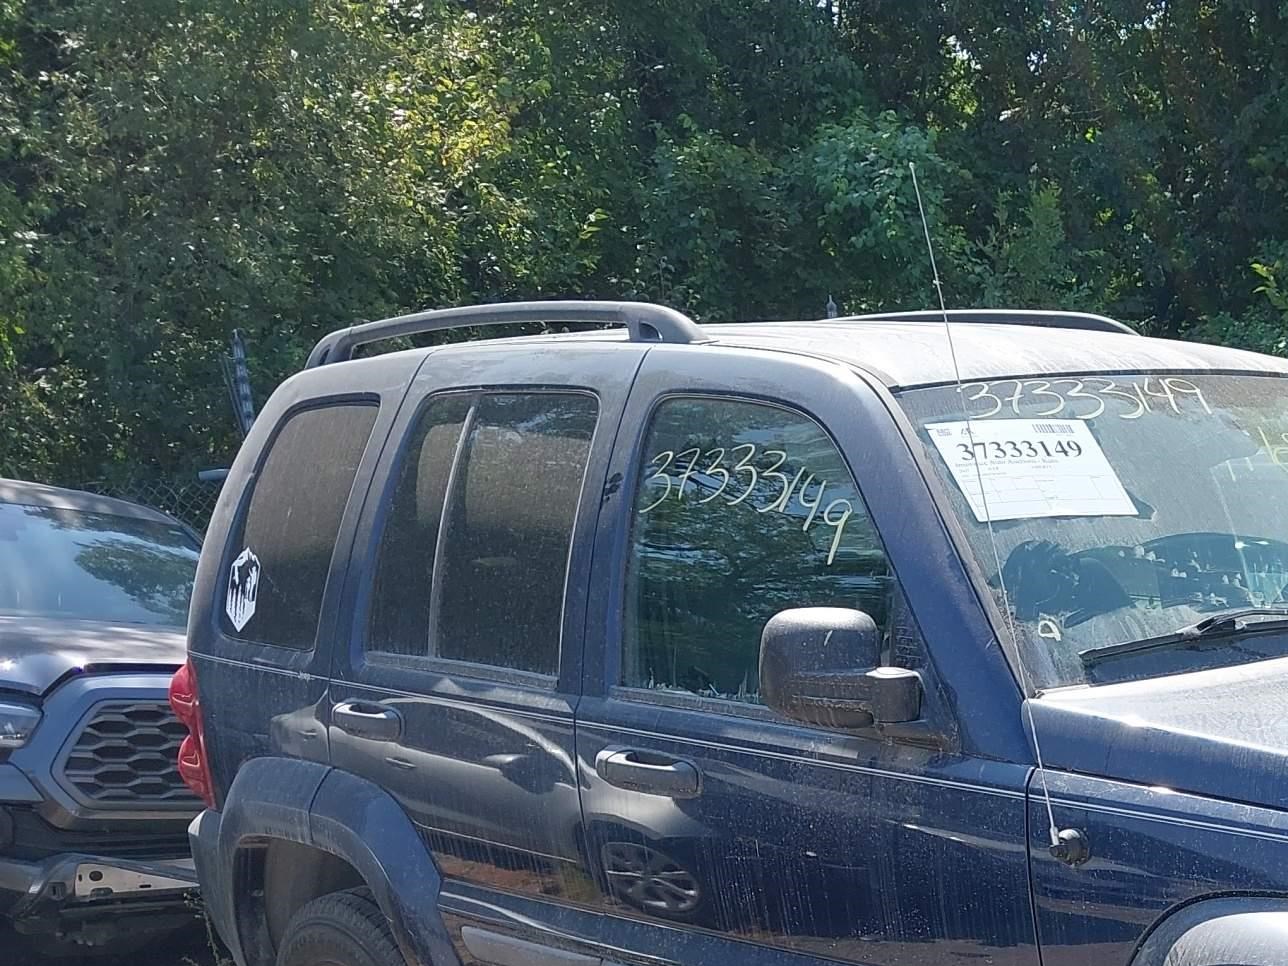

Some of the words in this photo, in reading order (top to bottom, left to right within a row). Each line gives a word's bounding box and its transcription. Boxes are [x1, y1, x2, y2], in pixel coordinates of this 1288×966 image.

[957, 378, 1212, 419] 37333149
[956, 439, 1082, 462] 37333149
[639, 443, 852, 566] 37333149
